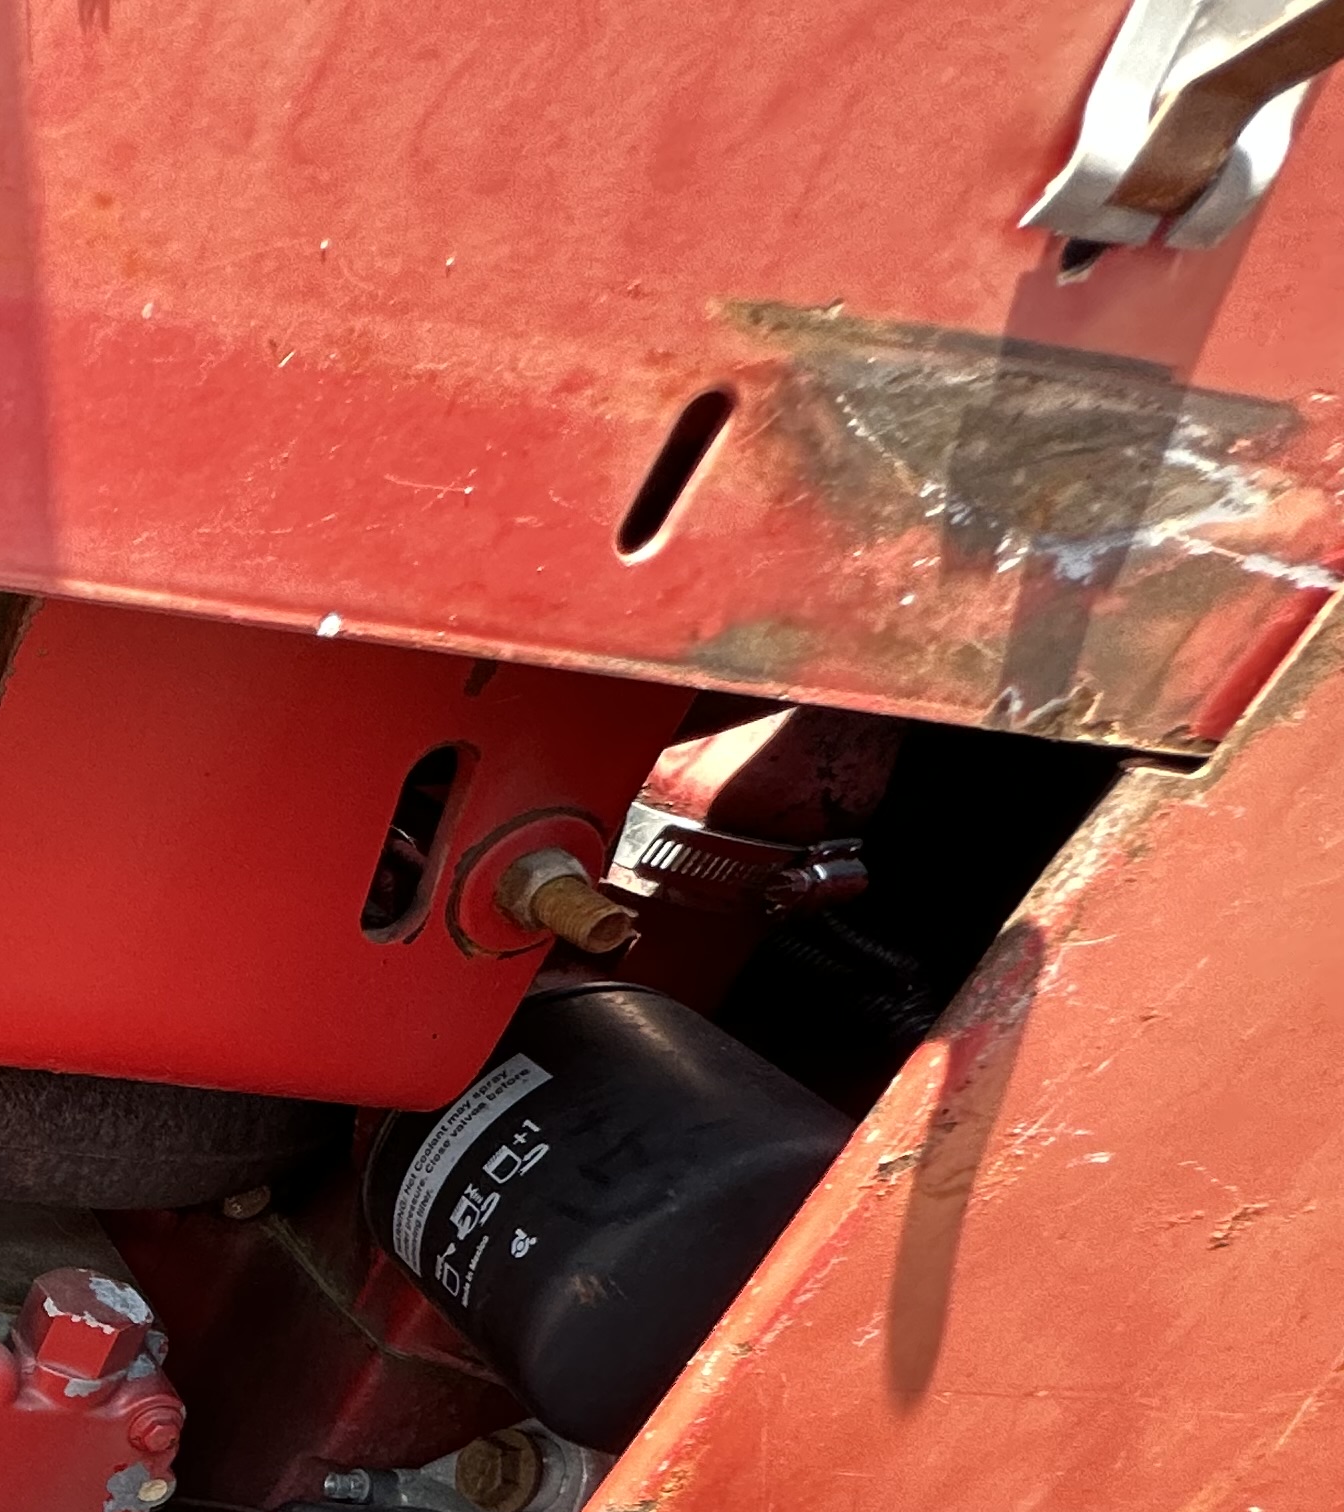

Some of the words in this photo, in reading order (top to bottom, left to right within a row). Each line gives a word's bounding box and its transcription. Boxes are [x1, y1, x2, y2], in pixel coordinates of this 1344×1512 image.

[414, 1125, 449, 1172] Coolant
[447, 1100, 472, 1125] may
[472, 1070, 507, 1099] spray
[425, 1139, 451, 1174] Close
[450, 1102, 487, 1138] valves
[486, 1068, 531, 1101] before
